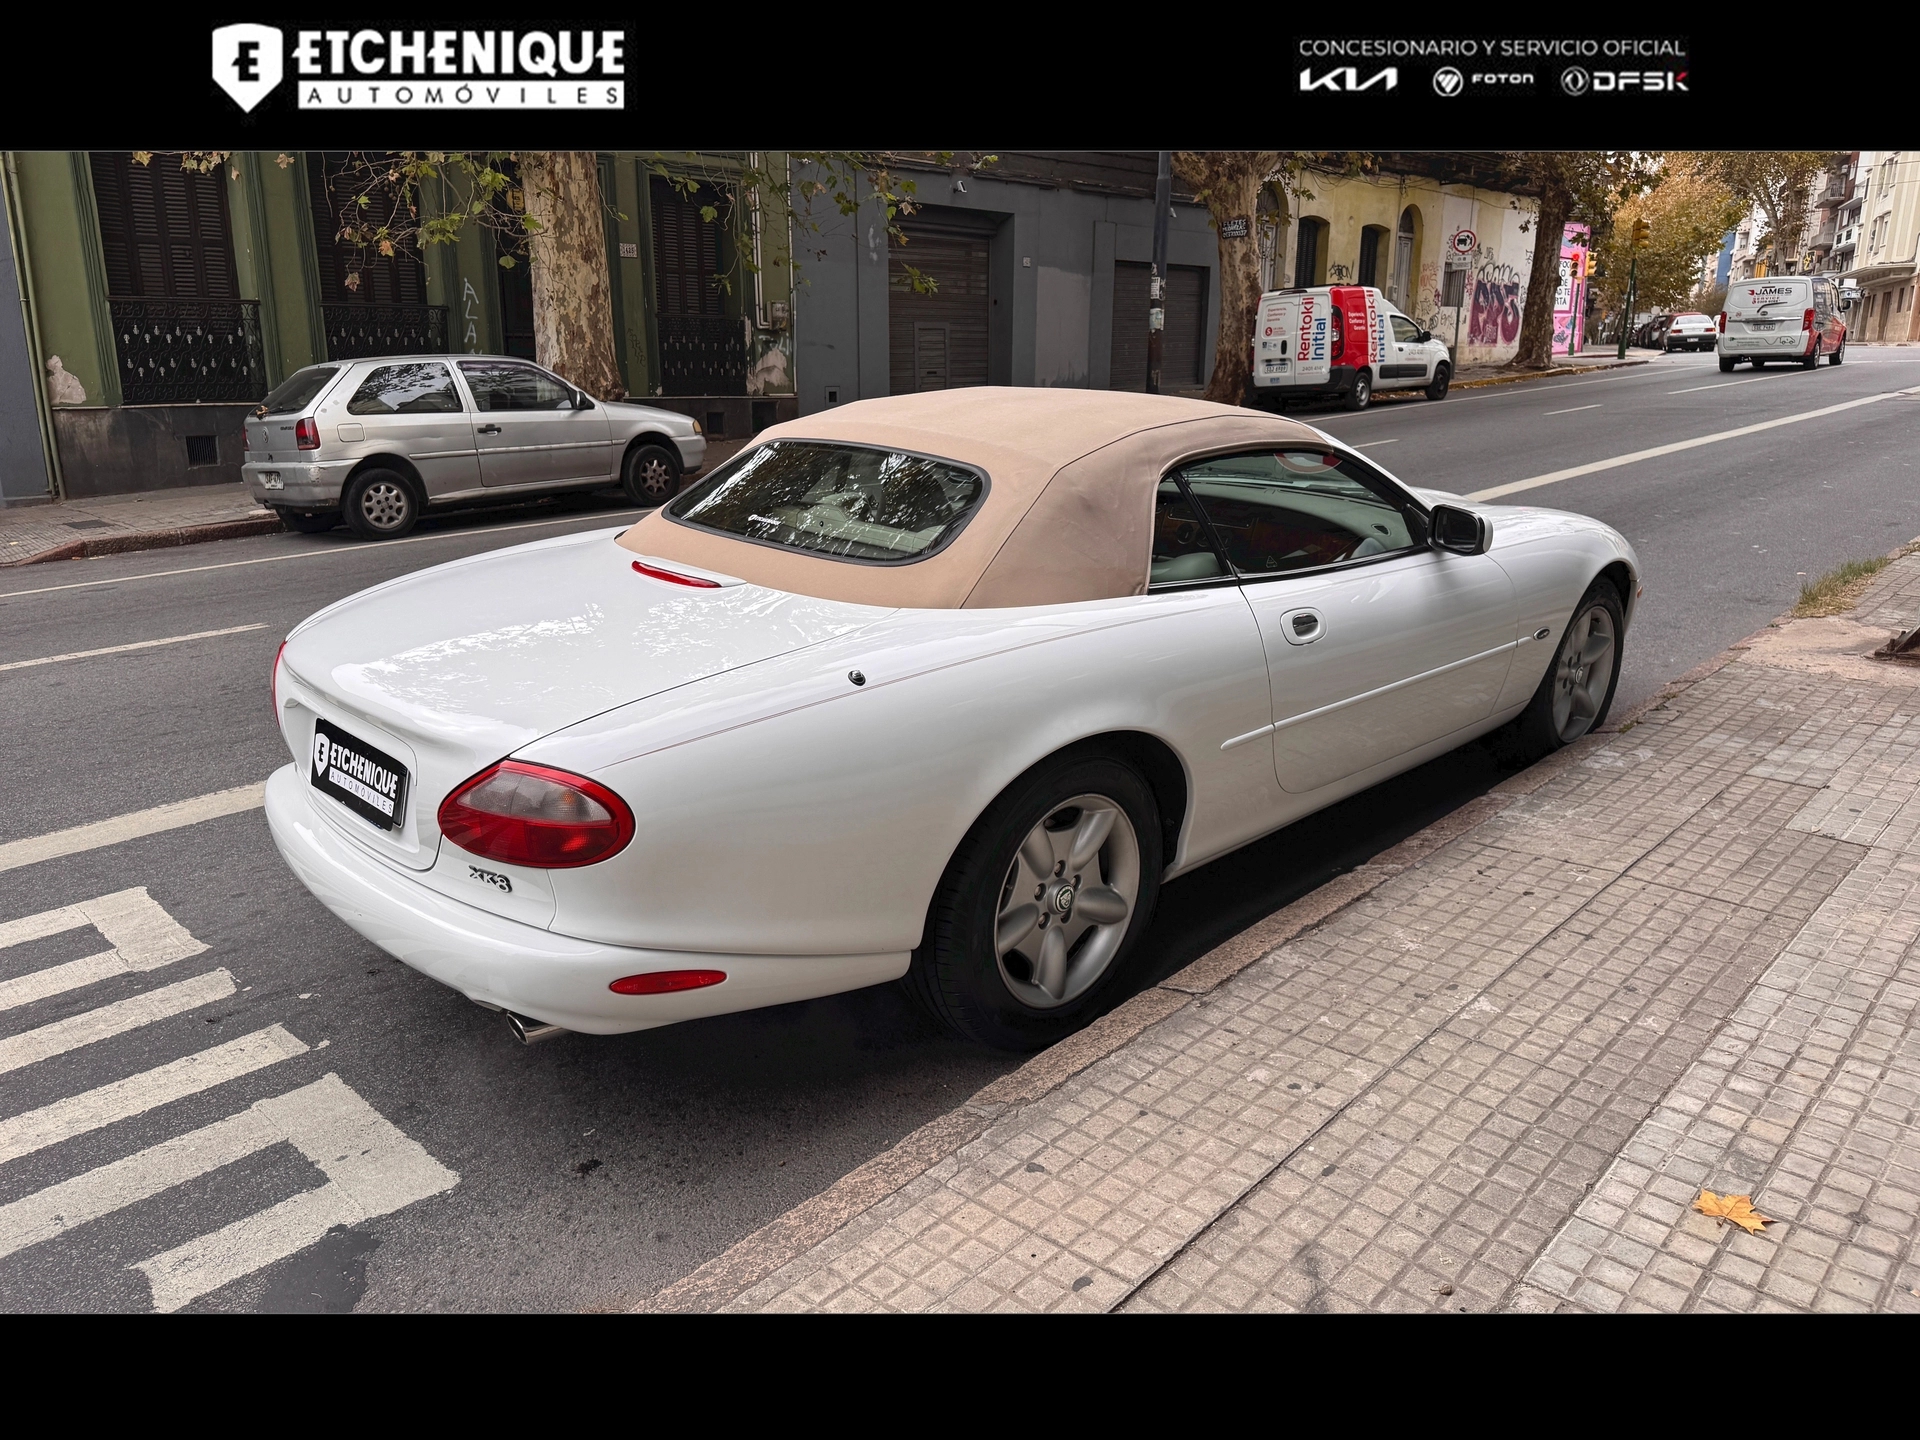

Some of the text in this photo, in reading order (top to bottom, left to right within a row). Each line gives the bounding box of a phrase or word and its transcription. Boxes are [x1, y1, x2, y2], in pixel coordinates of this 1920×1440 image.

[463, 277, 482, 355] ALA
[1297, 297, 1314, 361] Rentokil
[1311, 318, 1326, 360] Initial
[1366, 290, 1377, 363] Rentokil
[1377, 314, 1385, 362] Initial
[330, 742, 399, 799] ETCHENIQUE
[468, 865, 513, 893] XK8
